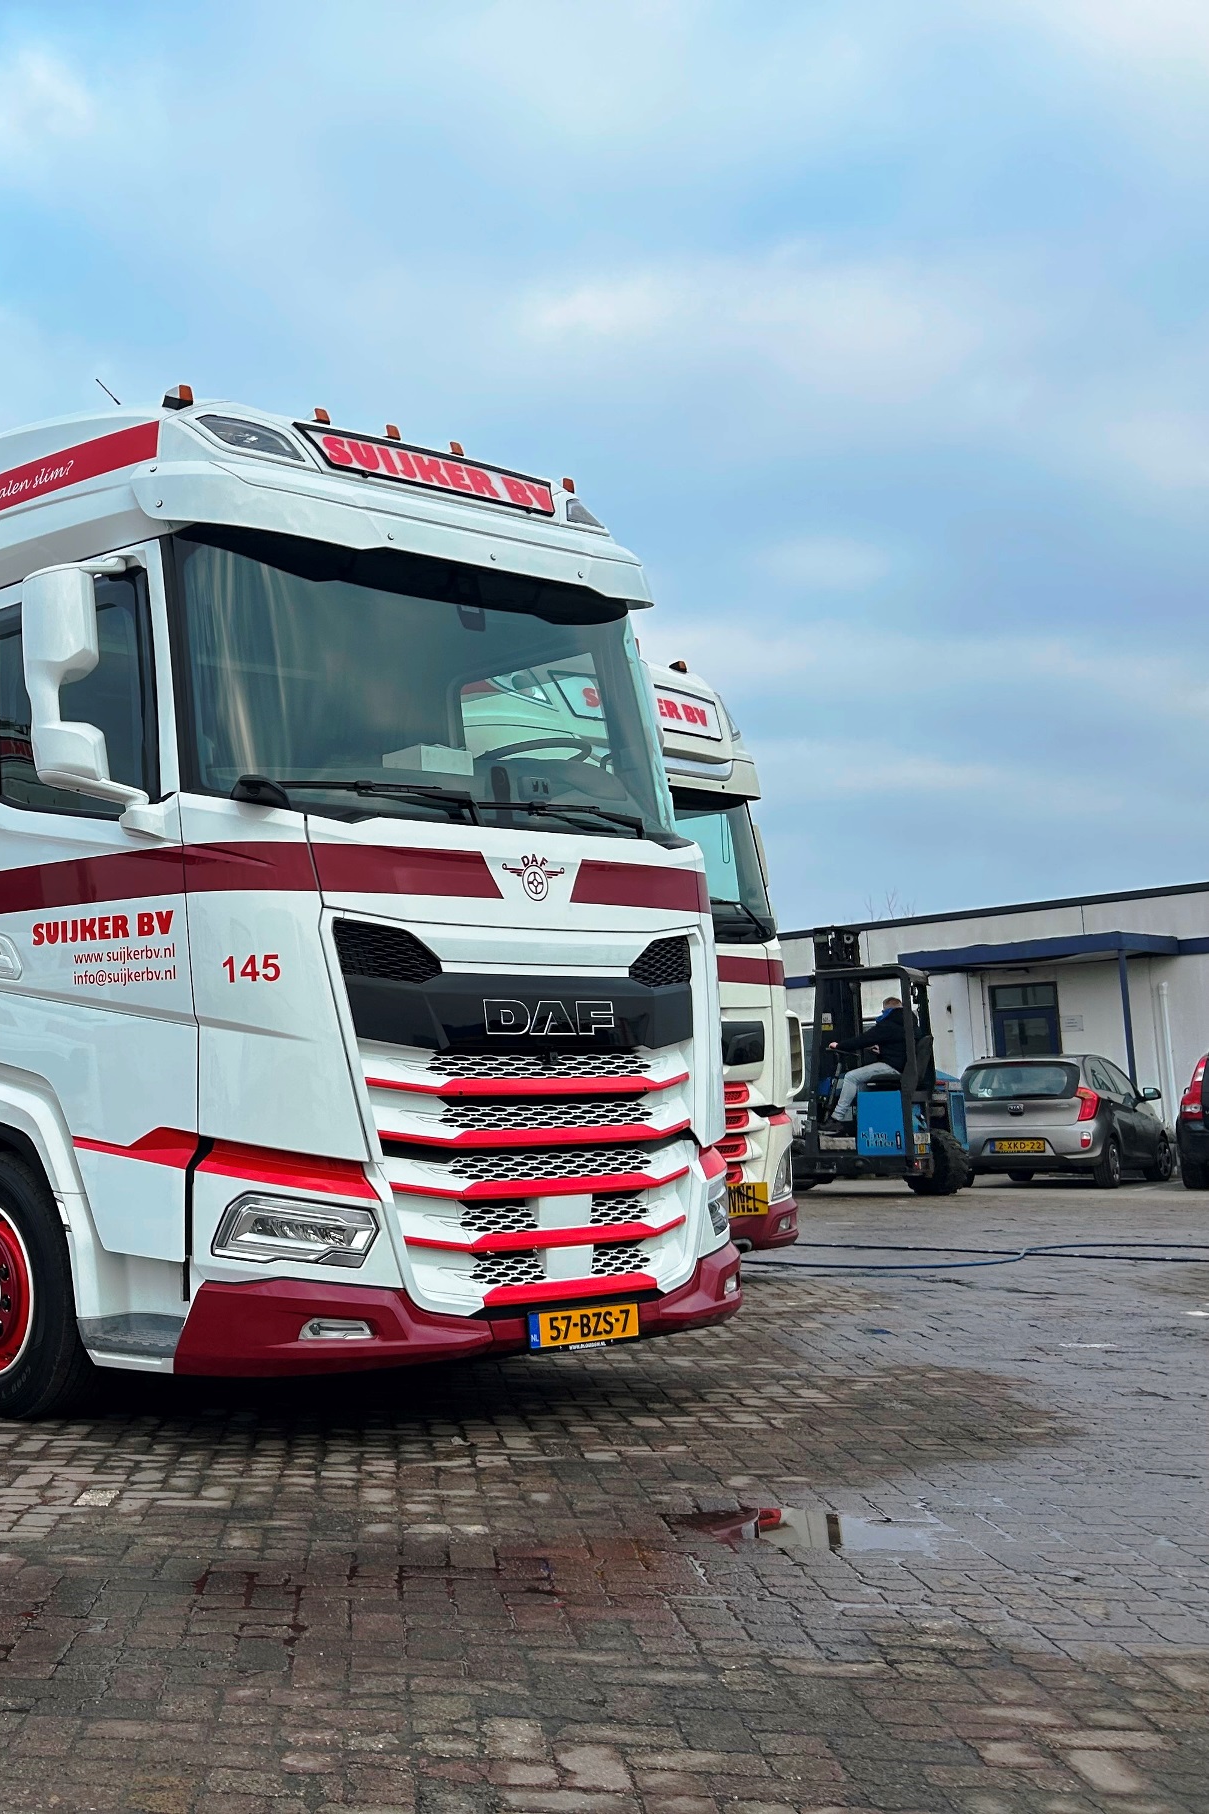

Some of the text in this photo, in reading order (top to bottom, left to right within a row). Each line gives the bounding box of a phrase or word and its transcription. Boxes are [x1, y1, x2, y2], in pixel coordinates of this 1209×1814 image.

[32, 459, 74, 489] slim?
[322, 435, 554, 513] SUIJKER BV
[681, 703, 708, 727] BV
[520, 853, 549, 868] DAF
[32, 909, 174, 946] SUIJKER BV
[73, 965, 177, 987] info@suijkerbv.nl
[222, 953, 281, 983] 145
[482, 998, 616, 1036] DAF
[998, 1141, 1042, 1150] 2-XKD-22
[530, 1334, 540, 1343] NL
[549, 1308, 630, 1341] 57-BZS-7
